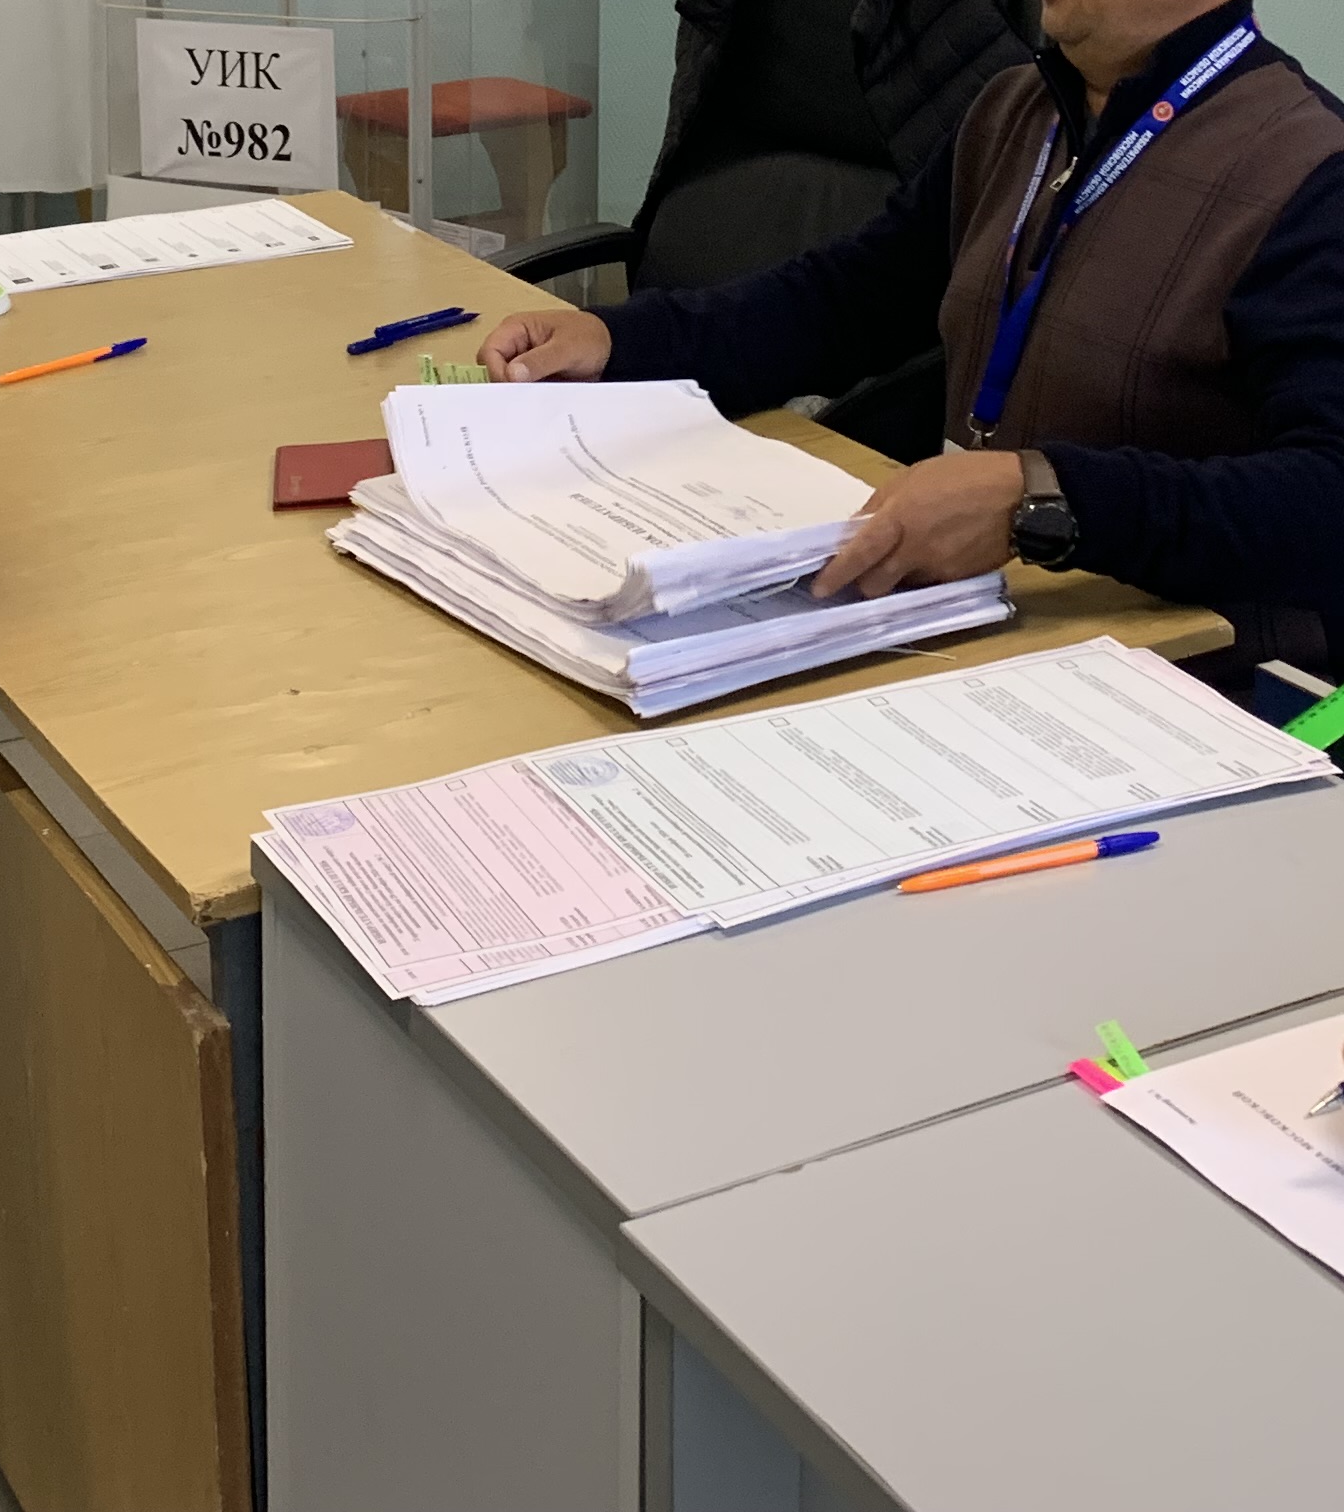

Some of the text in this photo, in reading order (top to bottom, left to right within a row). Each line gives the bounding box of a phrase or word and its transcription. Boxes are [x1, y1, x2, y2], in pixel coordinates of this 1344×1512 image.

[184, 48, 282, 90] УИК
[1179, 56, 1211, 87] ОБЛАСТИ
[1179, 65, 1217, 100] КОМИССИЯ
[178, 118, 292, 161] №982
[1104, 129, 1154, 184] ИЗБИРАТЕЛЬНАЯ
[1073, 129, 1139, 205] МОСКОВСКОЙ ОБЛАСТИ
[1230, 1088, 1314, 1151] МОСКОВСКОЙ
